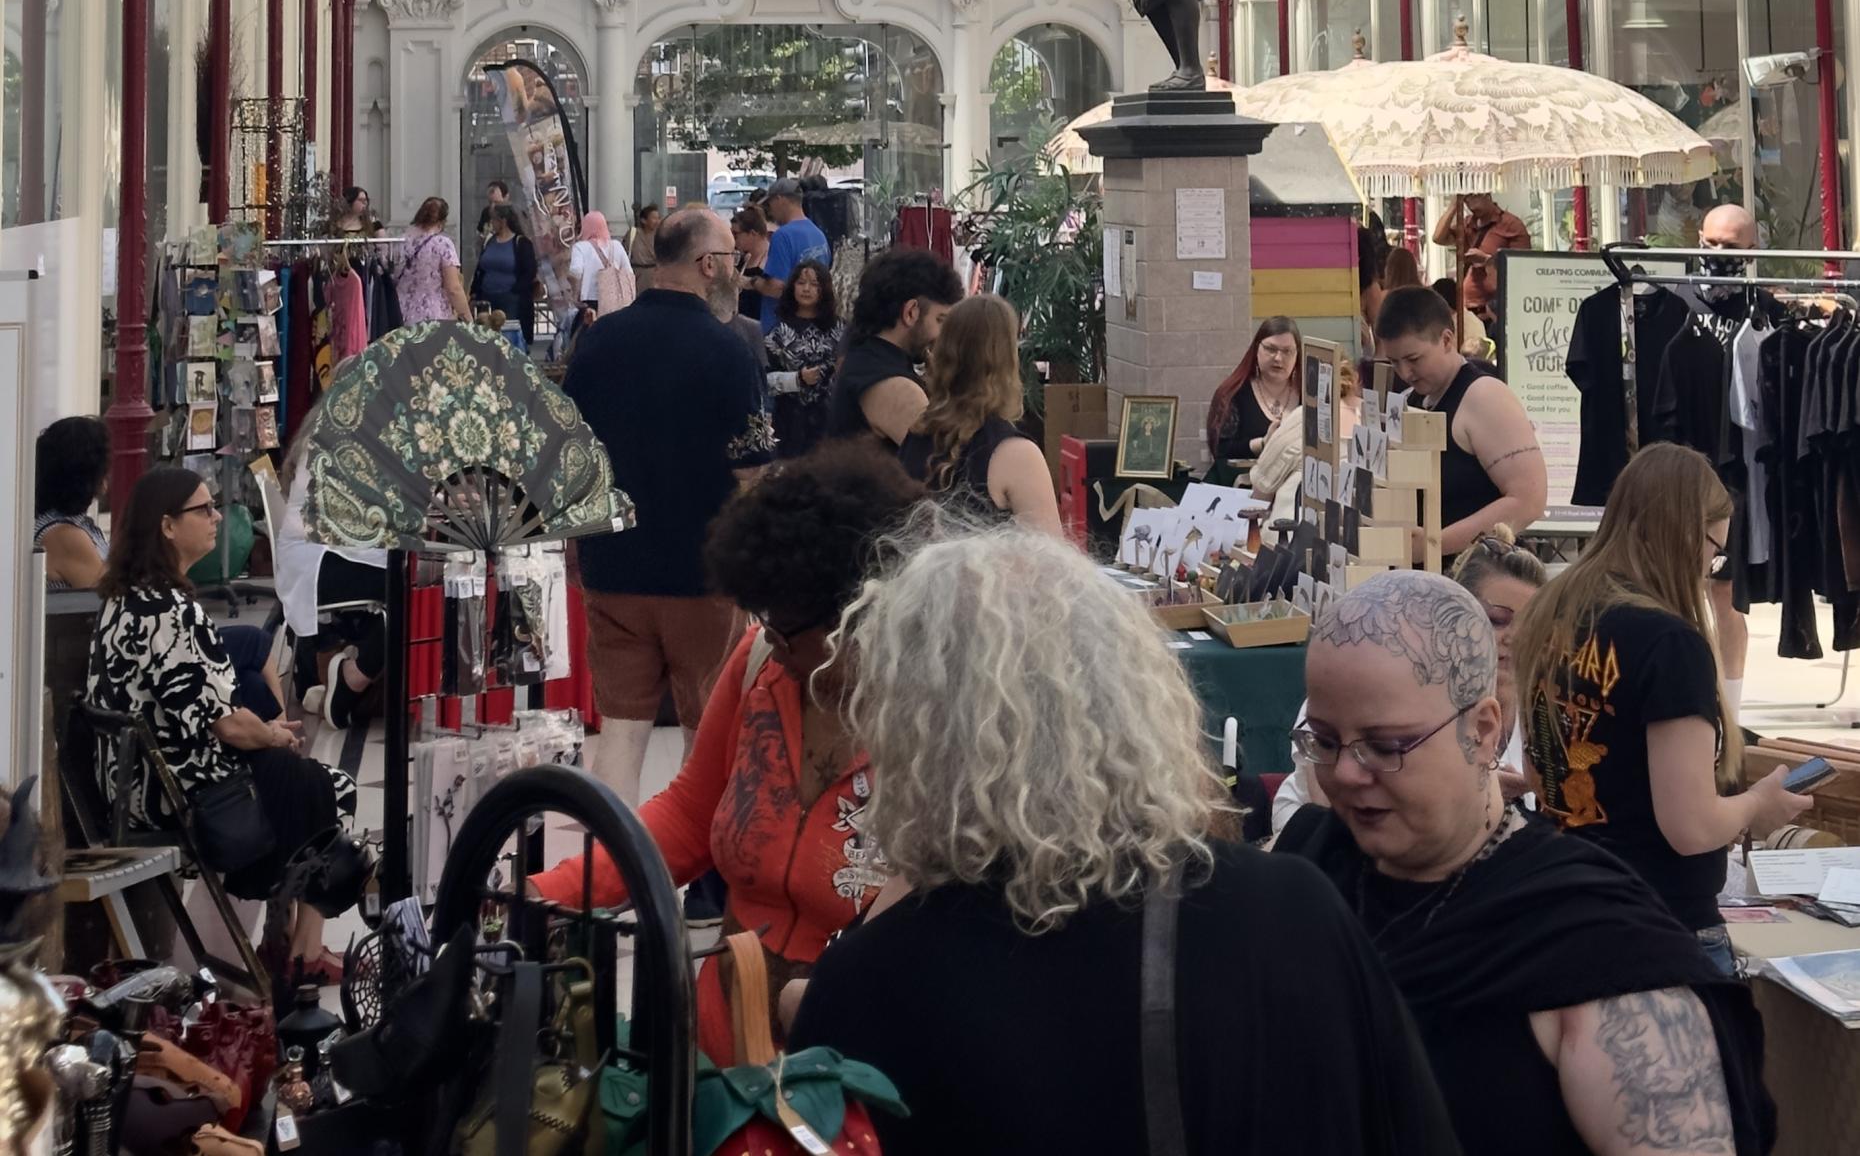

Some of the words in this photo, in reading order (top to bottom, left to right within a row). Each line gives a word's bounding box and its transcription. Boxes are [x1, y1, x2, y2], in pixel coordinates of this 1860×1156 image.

[1536, 268, 1573, 276] CREATING
[1574, 268, 1612, 277] COMMUN
[1522, 316, 1570, 352] refre
[1526, 355, 1566, 372] YOUR
[1546, 395, 1577, 403] company
